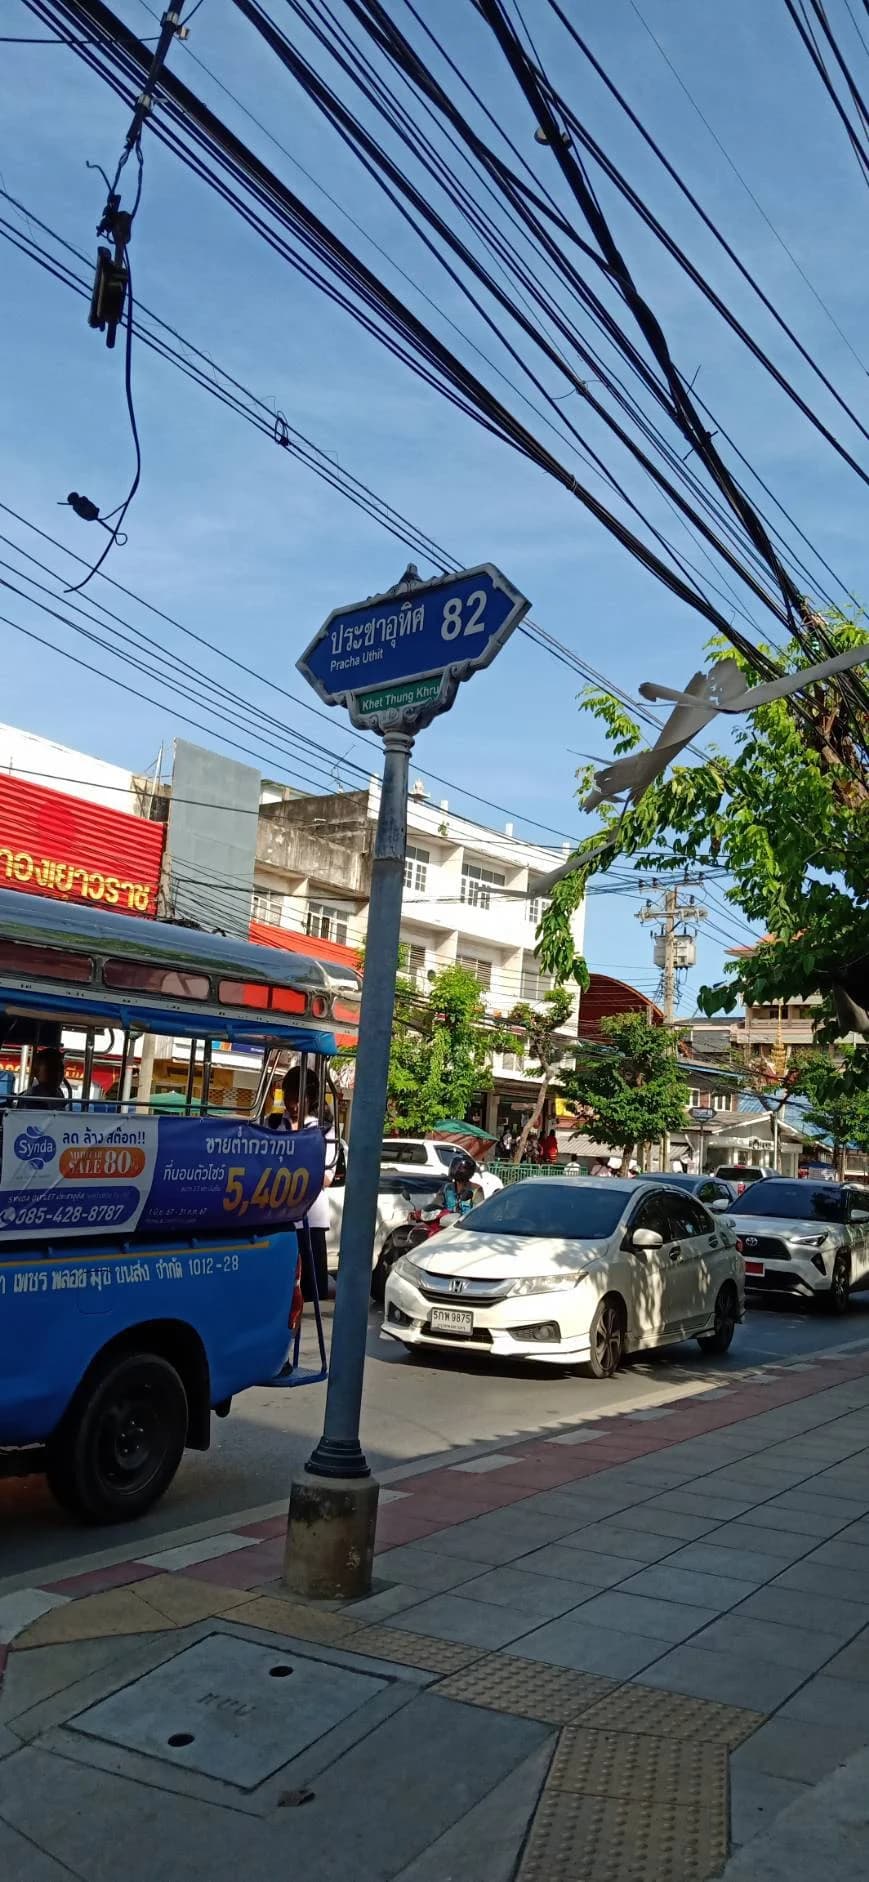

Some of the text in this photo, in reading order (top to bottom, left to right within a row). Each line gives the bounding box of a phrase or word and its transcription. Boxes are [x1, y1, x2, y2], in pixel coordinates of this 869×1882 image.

[331, 590, 488, 655] ประชาอุทิศ 82
[330, 649, 383, 671] Pracha Uthit
[361, 697, 383, 711] Khet
[384, 690, 414, 706] Thung
[18, 1139, 53, 1157] Synda
[223, 1166, 310, 1217] 5,400
[16, 1205, 125, 1225] 085-428-8787
[189, 1255, 239, 1276] 1012-28
[451, 1312, 471, 1324] 9875
